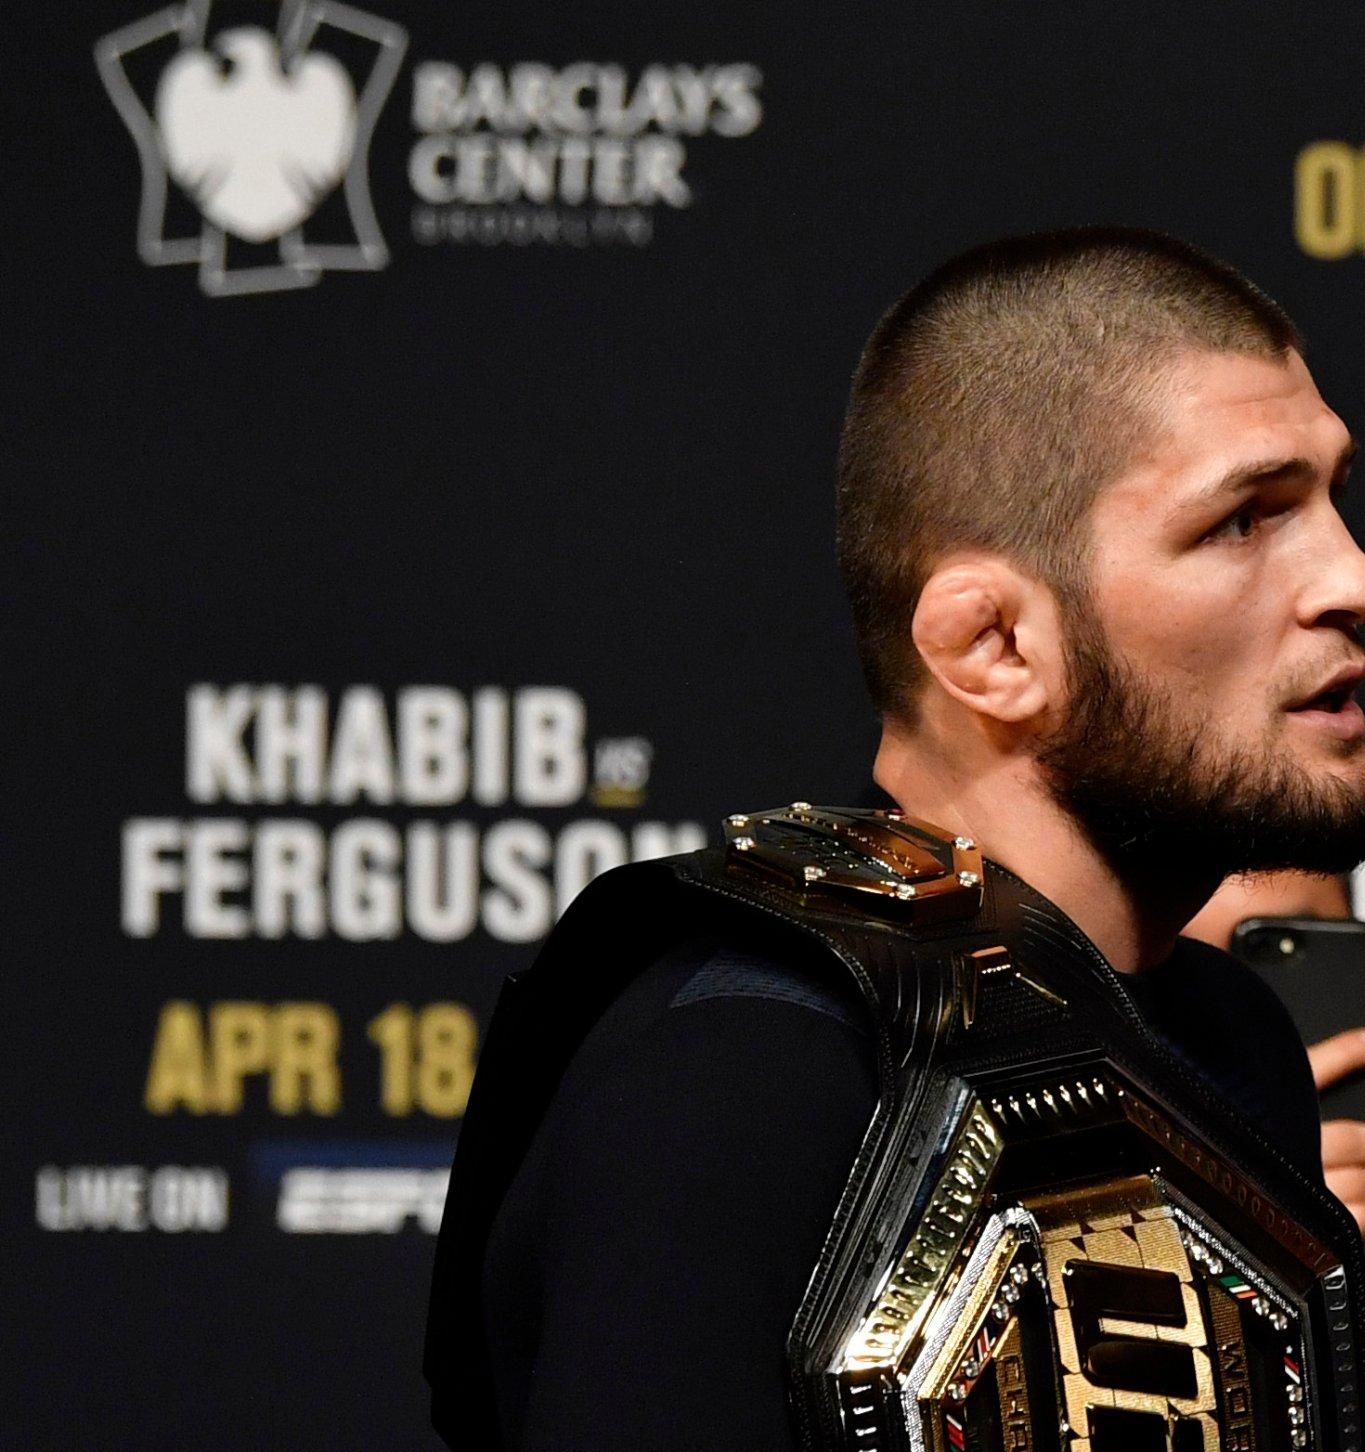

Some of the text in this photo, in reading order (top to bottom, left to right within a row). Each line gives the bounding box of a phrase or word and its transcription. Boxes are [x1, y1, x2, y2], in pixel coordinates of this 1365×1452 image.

[410, 62, 763, 136] BARCLAYS
[409, 136, 695, 209] CENTER
[186, 684, 588, 805] KHABIB
[145, 1003, 478, 1118] APR 18
[35, 1166, 148, 1232] LIVE
[151, 1166, 229, 1232] ON
